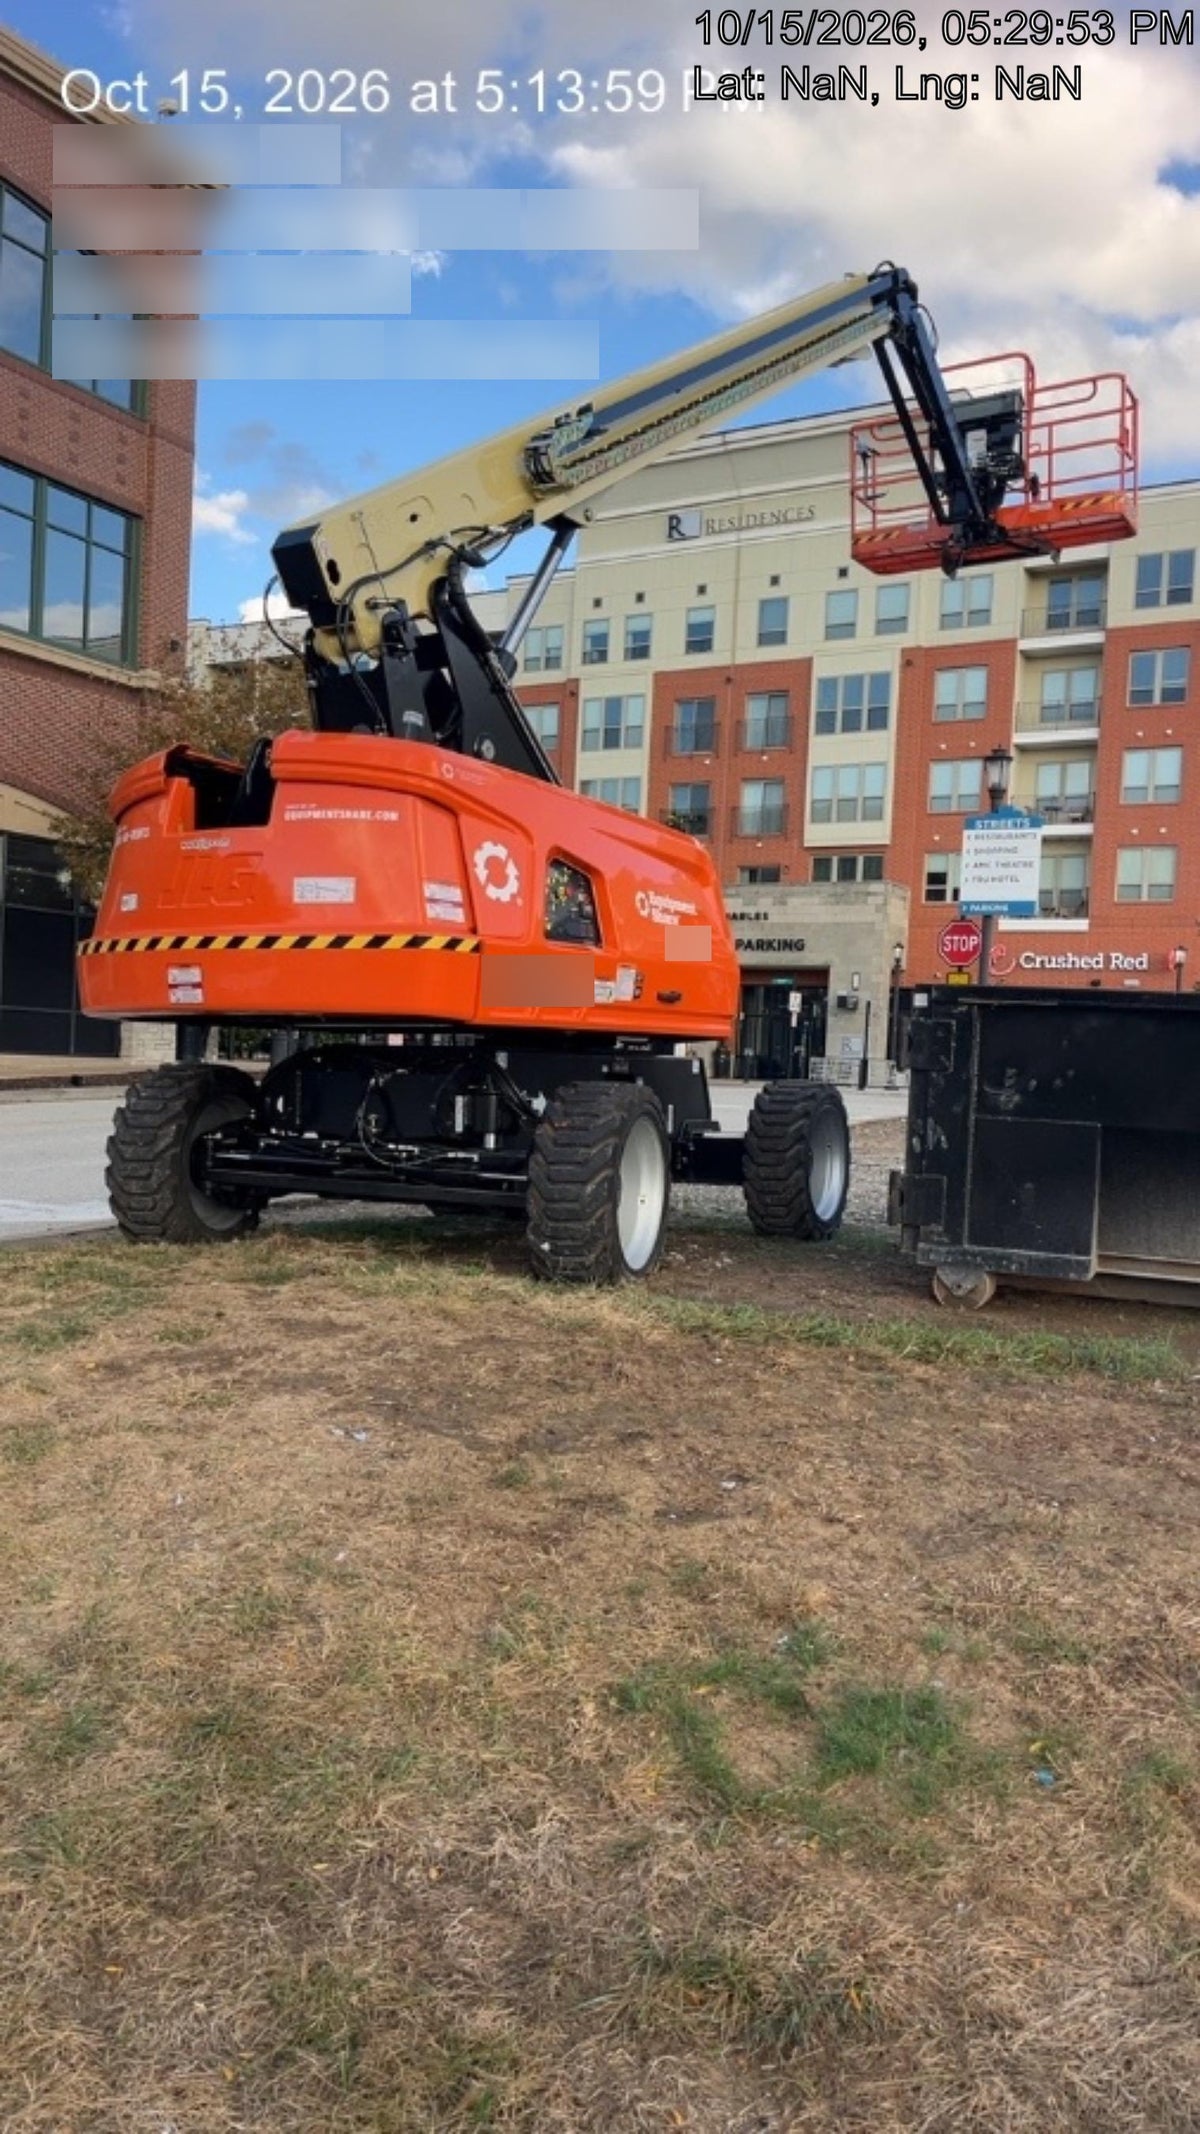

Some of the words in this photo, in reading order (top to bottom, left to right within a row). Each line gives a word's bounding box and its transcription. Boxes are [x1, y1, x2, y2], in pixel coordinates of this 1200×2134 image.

[705, 504, 816, 536] RESIDENCES
[975, 818, 1030, 829] STREETS
[969, 903, 1009, 912] PARKING
[735, 938, 805, 952] PARKING
[943, 936, 979, 952] STOP
[1019, 952, 1104, 971] Crushed
[1109, 952, 1149, 971] Red
